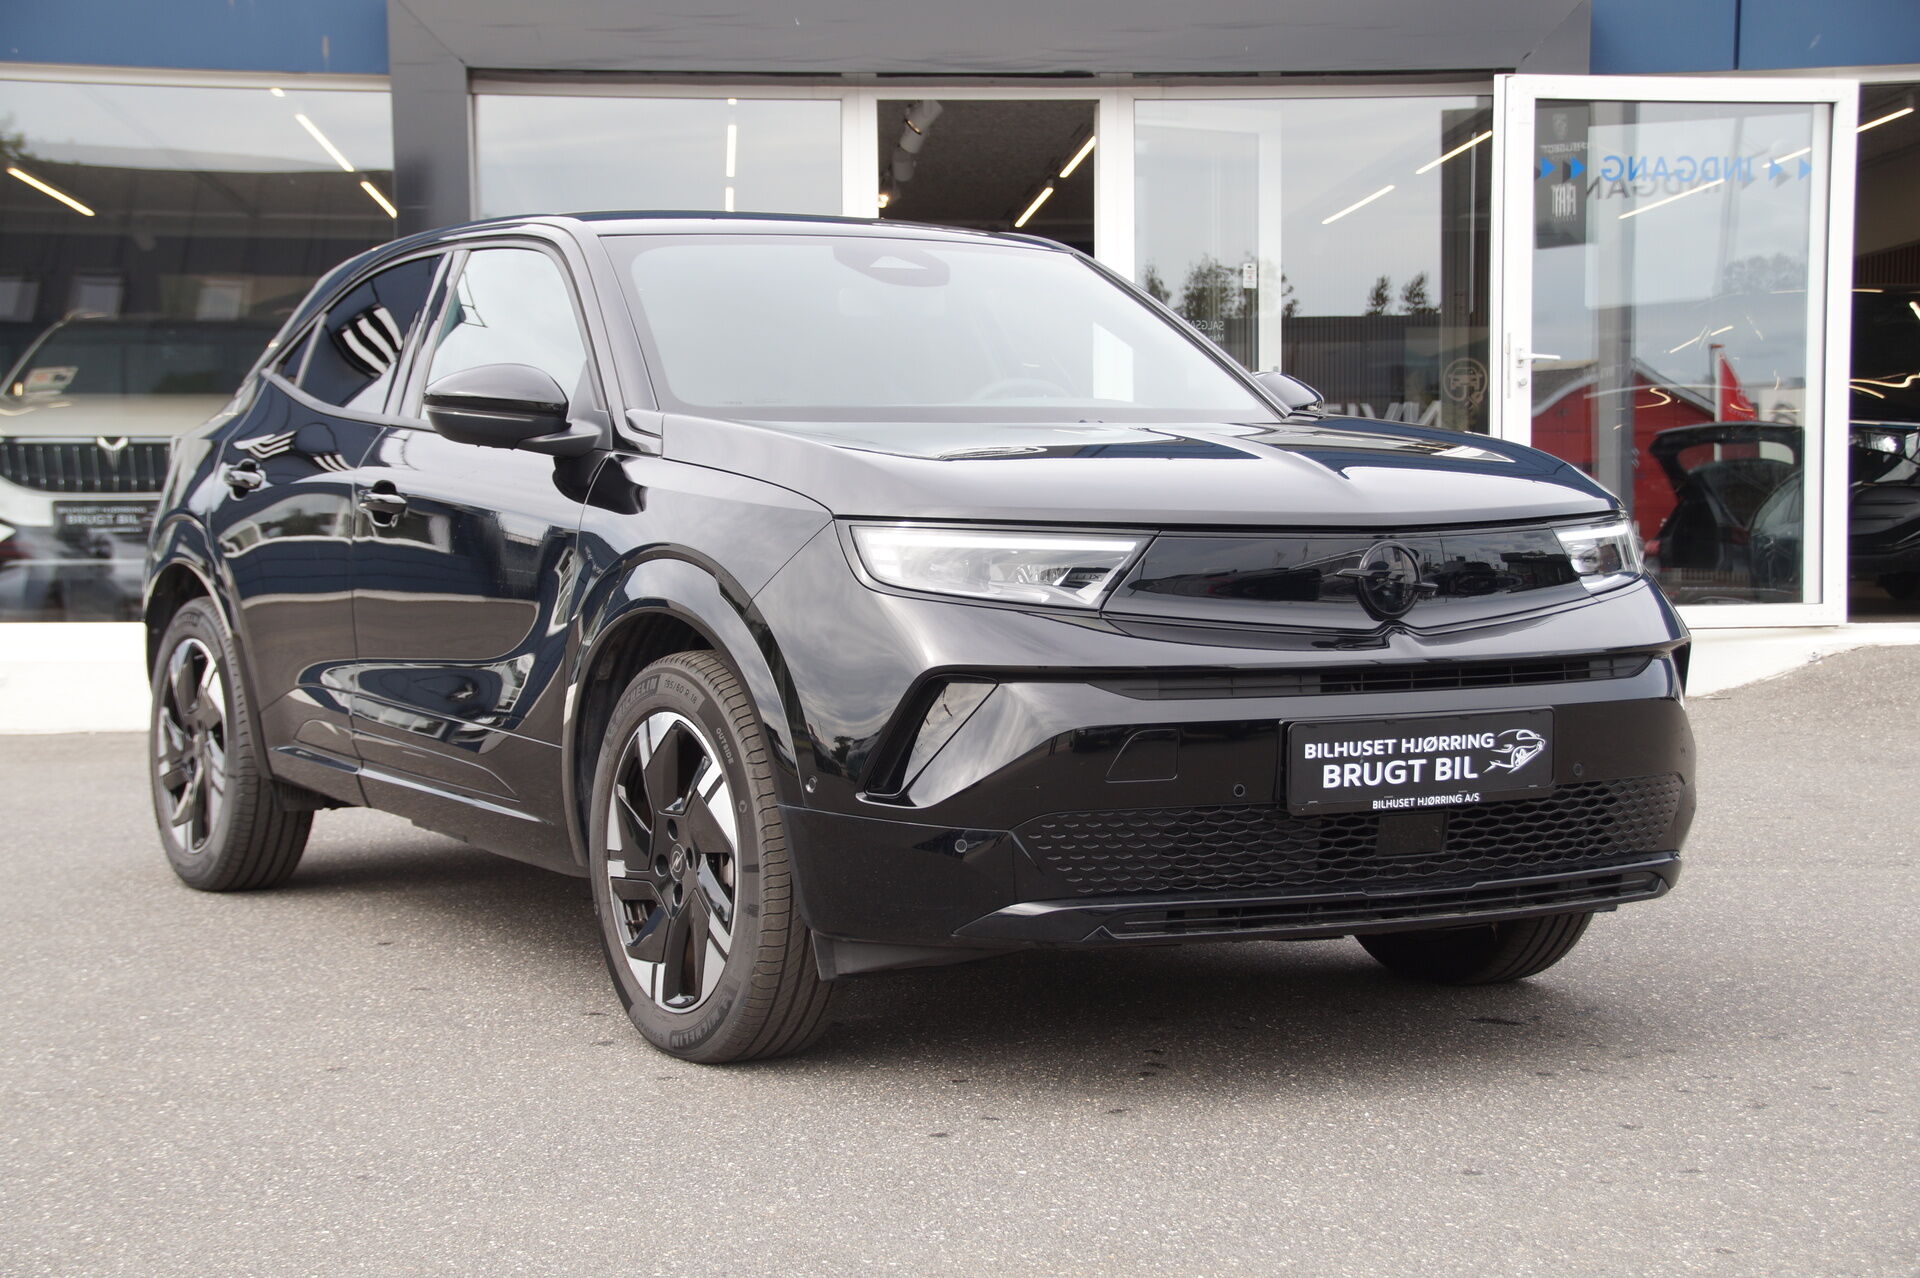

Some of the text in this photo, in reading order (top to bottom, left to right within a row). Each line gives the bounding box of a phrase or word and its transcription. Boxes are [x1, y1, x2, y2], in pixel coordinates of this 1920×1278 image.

[715, 727, 735, 765] OUTSIDE
[1304, 732, 1495, 759] BILHUSET HJØRRING
[1322, 756, 1479, 788] BRUGT BIL
[1372, 792, 1480, 810] BILHUSET HJØRRING A/S
